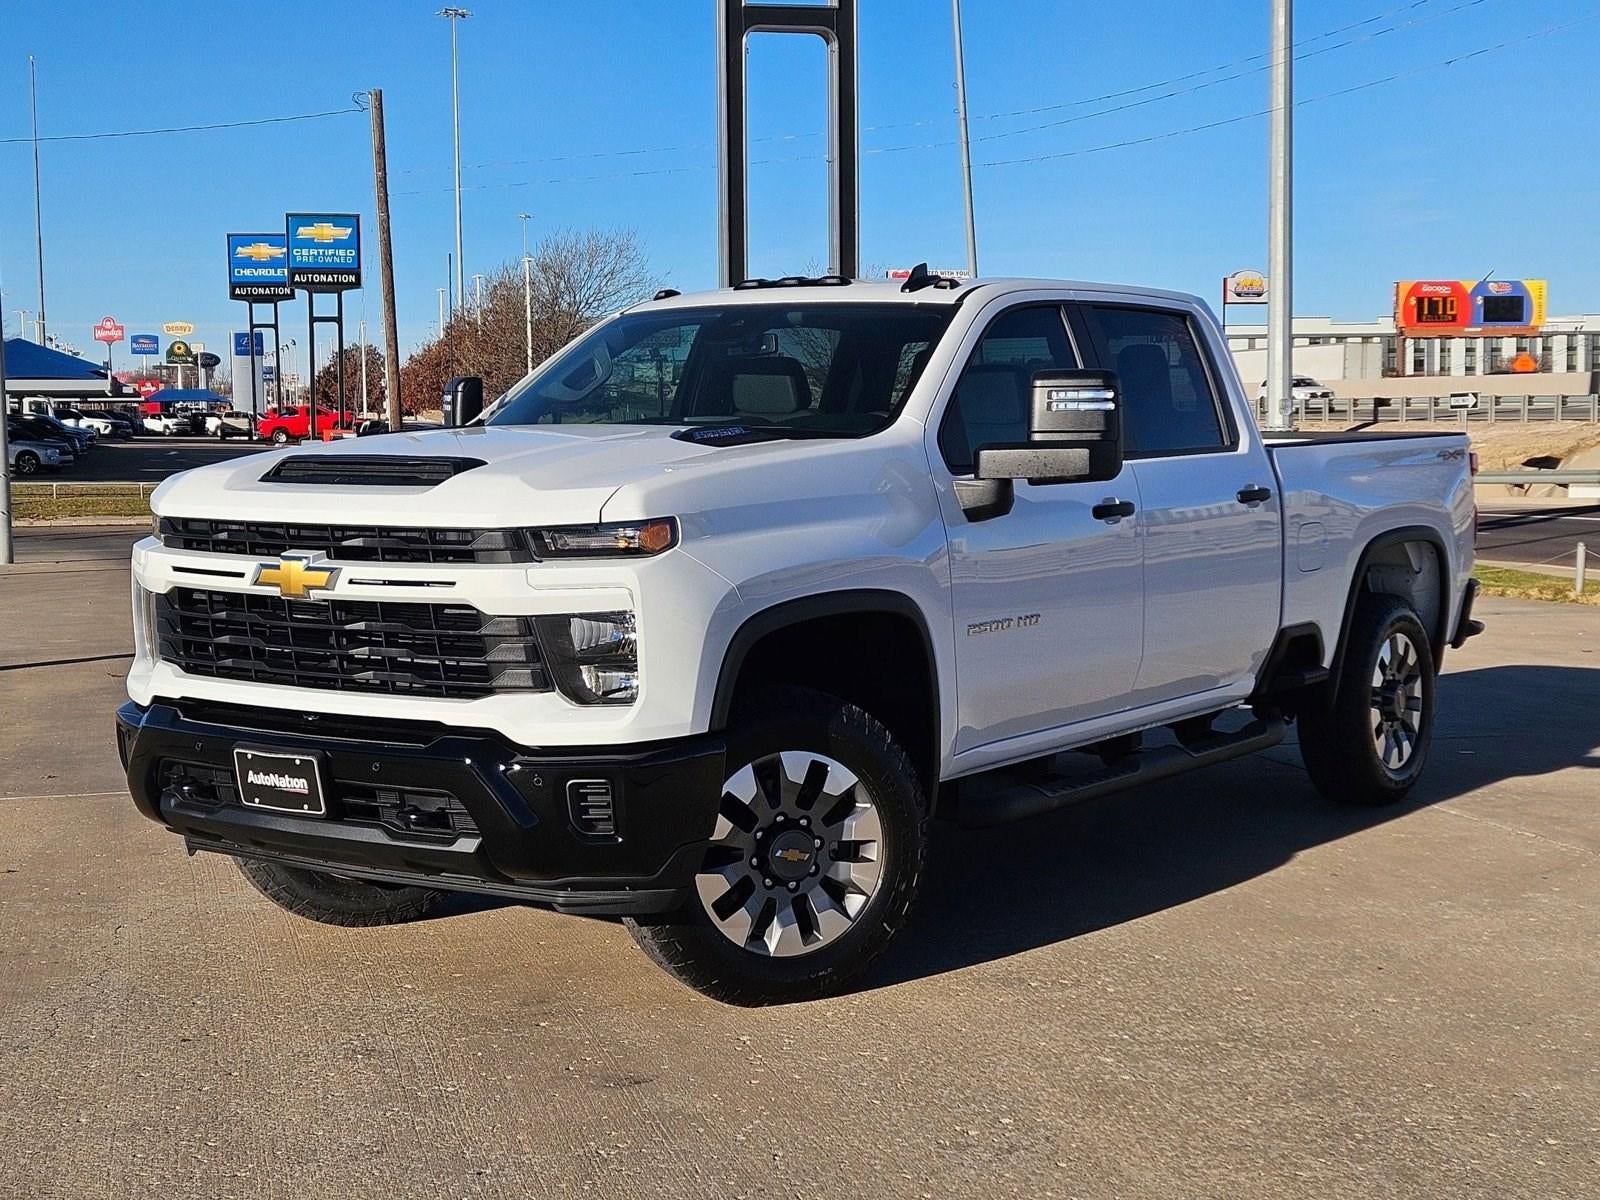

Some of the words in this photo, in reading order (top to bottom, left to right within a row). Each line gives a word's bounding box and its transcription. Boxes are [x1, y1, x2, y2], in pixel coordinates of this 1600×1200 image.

[234, 268, 288, 276] CHEVROLET
[294, 274, 356, 283] AUTONATION
[234, 287, 291, 295] AUTONATION
[95, 329, 122, 338] Wendy's
[247, 770, 308, 789] AutoNation
